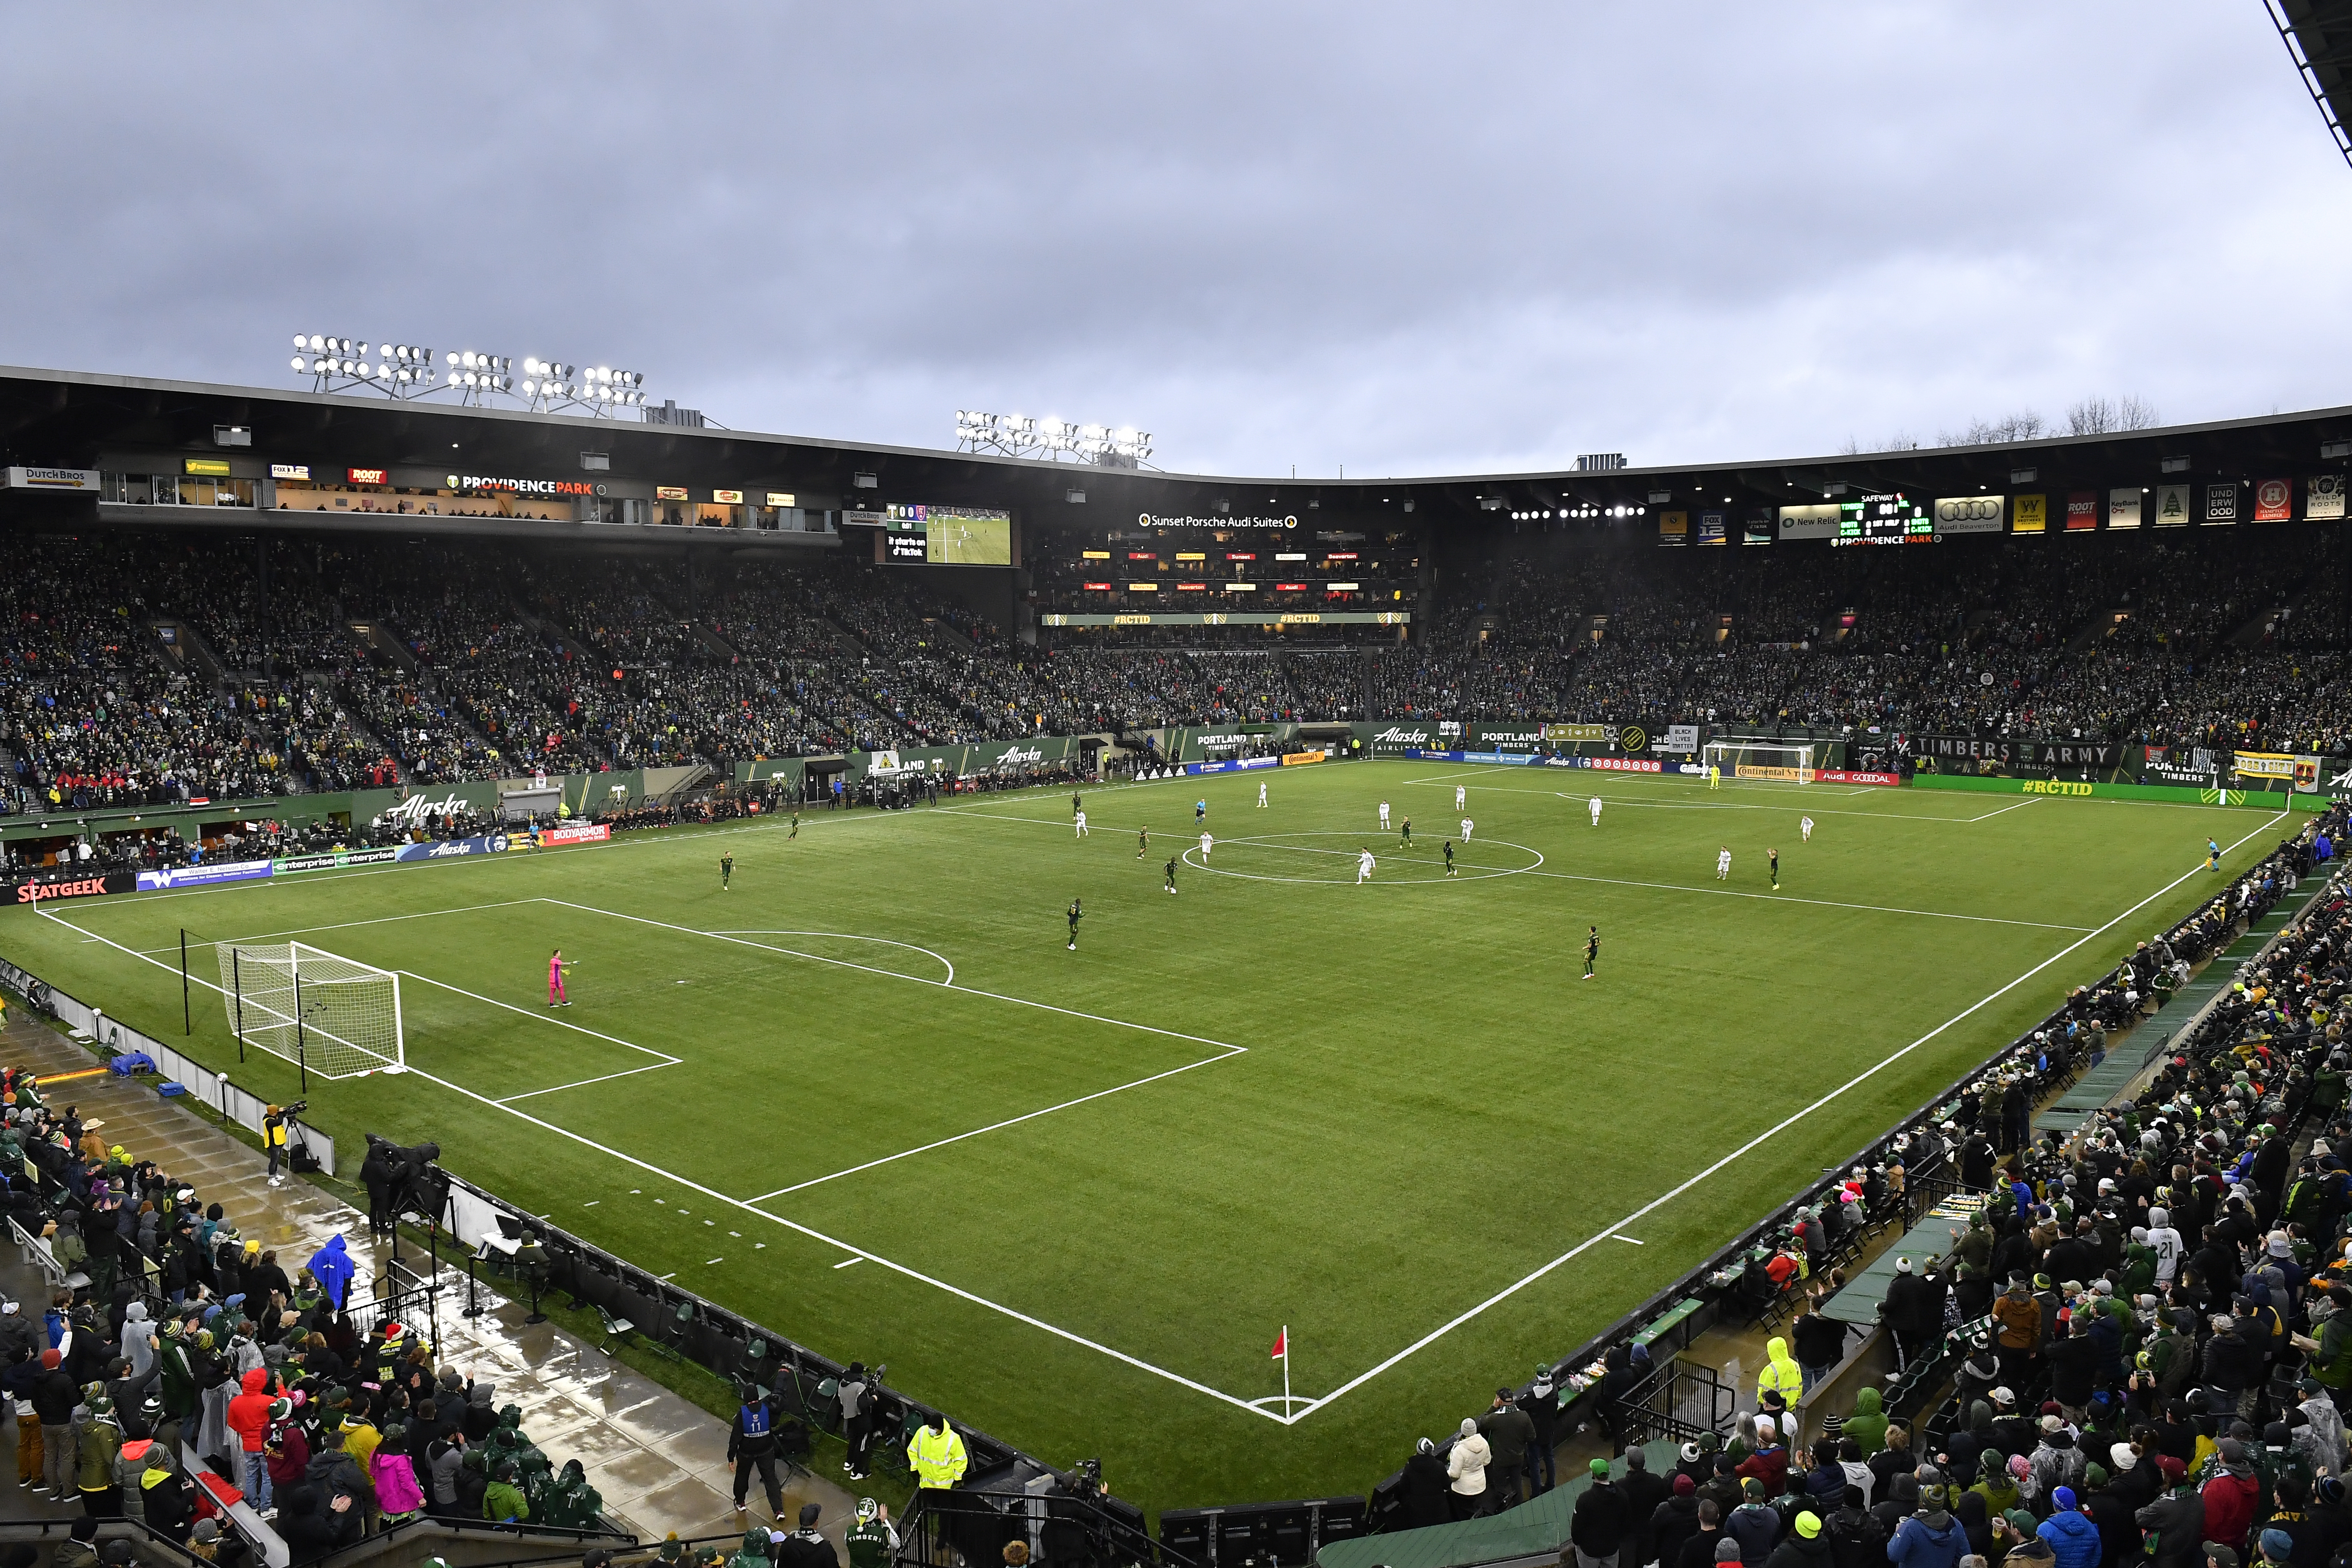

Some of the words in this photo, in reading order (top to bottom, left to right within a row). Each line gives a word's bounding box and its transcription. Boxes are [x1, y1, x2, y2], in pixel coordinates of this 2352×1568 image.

[287, 466, 309, 474] 12
[353, 469, 382, 479] ROOT
[1861, 494, 1894, 502] SAFEWAY
[899, 506, 905, 517] 0
[2068, 502, 2095, 511] ROOT
[2210, 507, 2233, 516] OOD
[908, 507, 914, 517] 0
[1152, 515, 1184, 526] Sunset
[1186, 516, 1226, 527] Porsche
[1228, 517, 1251, 527] Audi
[1253, 517, 1283, 527] Suites
[1817, 517, 1837, 525] Relic
[1699, 526, 1724, 536] 12
[889, 536, 894, 545] it
[895, 537, 916, 546] starts
[900, 548, 923, 556] TikTok
[1114, 615, 1151, 624] #RCTID
[1280, 614, 1320, 623] #RCTID
[1198, 734, 1246, 745] PORTLAND
[1373, 727, 1428, 744] Alaska
[1481, 733, 1540, 741] PORTLAND
[1918, 737, 2010, 758] TIMBERS
[996, 746, 1042, 764] Alaska
[1289, 753, 1314, 764] Continental
[2045, 747, 2109, 763] ARMY
[1544, 757, 1570, 767] Alaska
[2268, 761, 2292, 772] CITY
[1738, 766, 1784, 776] Continental
[2161, 772, 2204, 782] TIMBERS
[2022, 780, 2092, 796] #RCTID
[386, 793, 468, 817] Alaska
[553, 825, 605, 840] BODYARMOR
[429, 841, 470, 856] Alaska
[336, 850, 394, 864] enterprise
[273, 857, 334, 871] enterprise
[2159, 1241, 2173, 1259] 21
[379, 1347, 400, 1355] PORTLAND
[751, 1421, 761, 1432] 11
